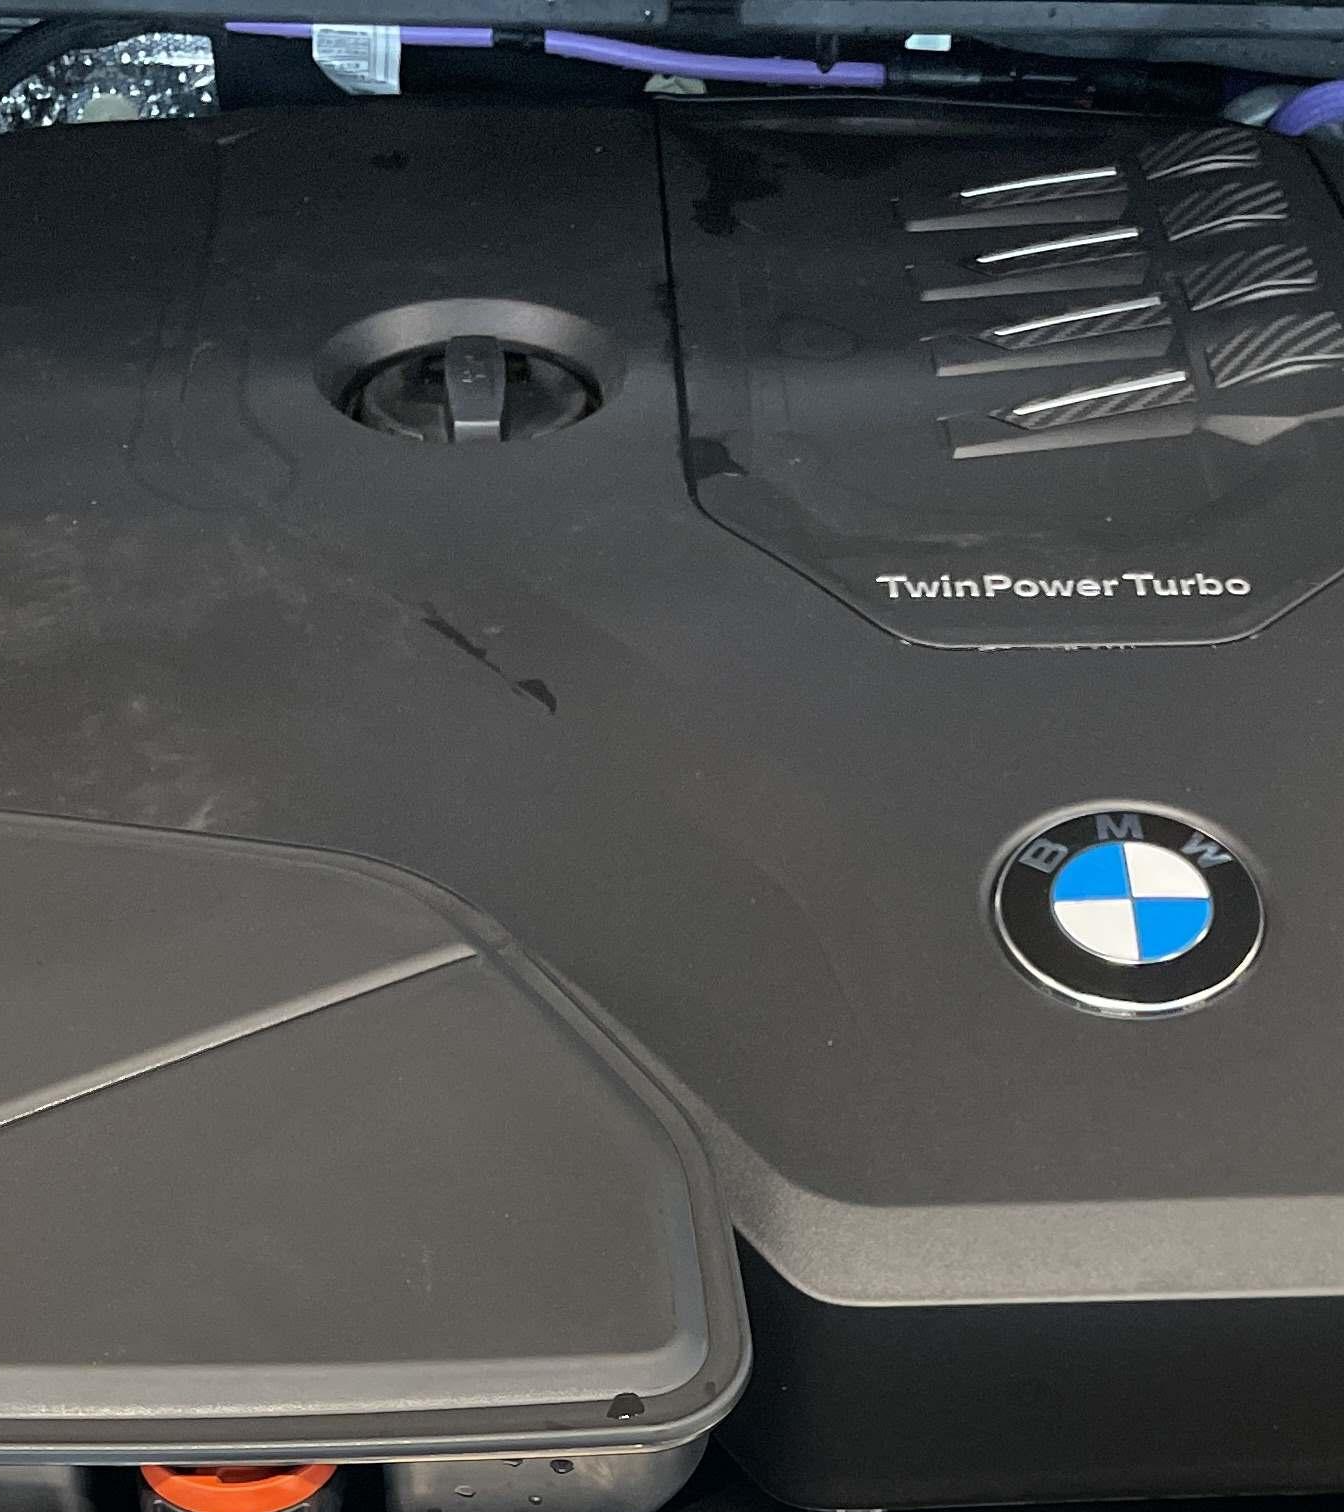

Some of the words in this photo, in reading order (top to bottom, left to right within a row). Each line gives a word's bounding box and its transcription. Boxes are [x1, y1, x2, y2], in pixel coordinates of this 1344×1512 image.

[876, 573, 1119, 598] TwinPower
[1123, 572, 1251, 597] Turbo
[1018, 813, 1234, 874] BMW
